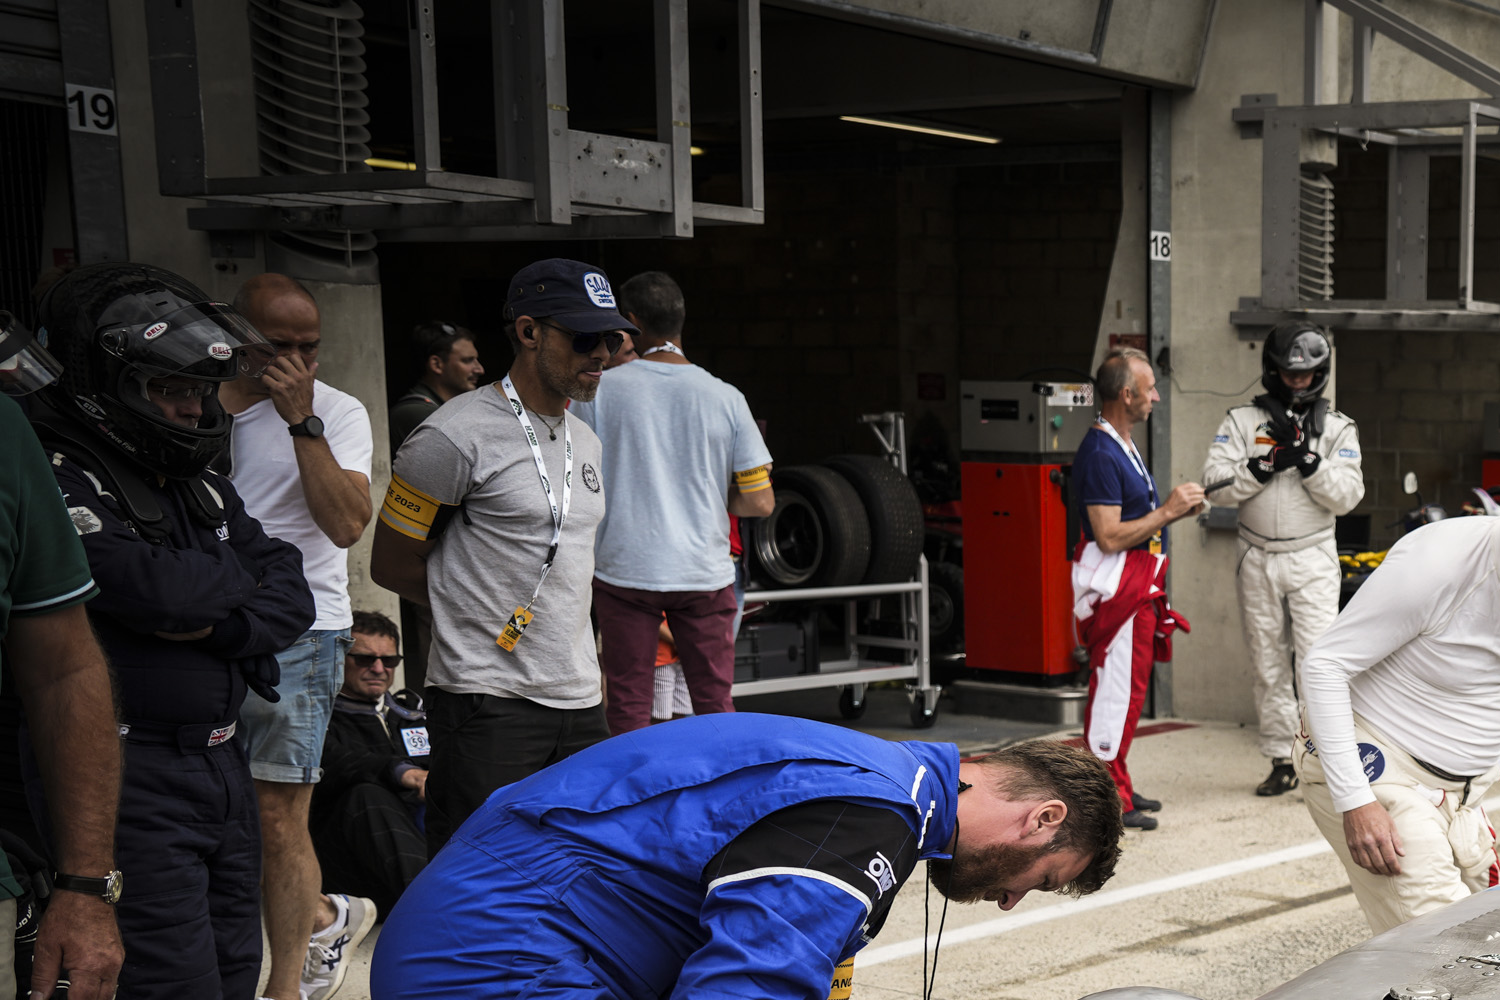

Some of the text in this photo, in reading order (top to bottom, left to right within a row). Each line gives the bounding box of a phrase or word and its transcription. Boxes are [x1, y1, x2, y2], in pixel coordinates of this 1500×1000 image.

[68, 90, 115, 130] 19
[1152, 235, 1171, 258] 18
[145, 325, 165, 337] BELL
[212, 346, 231, 356] BELL
[107, 431, 137, 454] Pete Fisk
[395, 494, 421, 513] 2023
